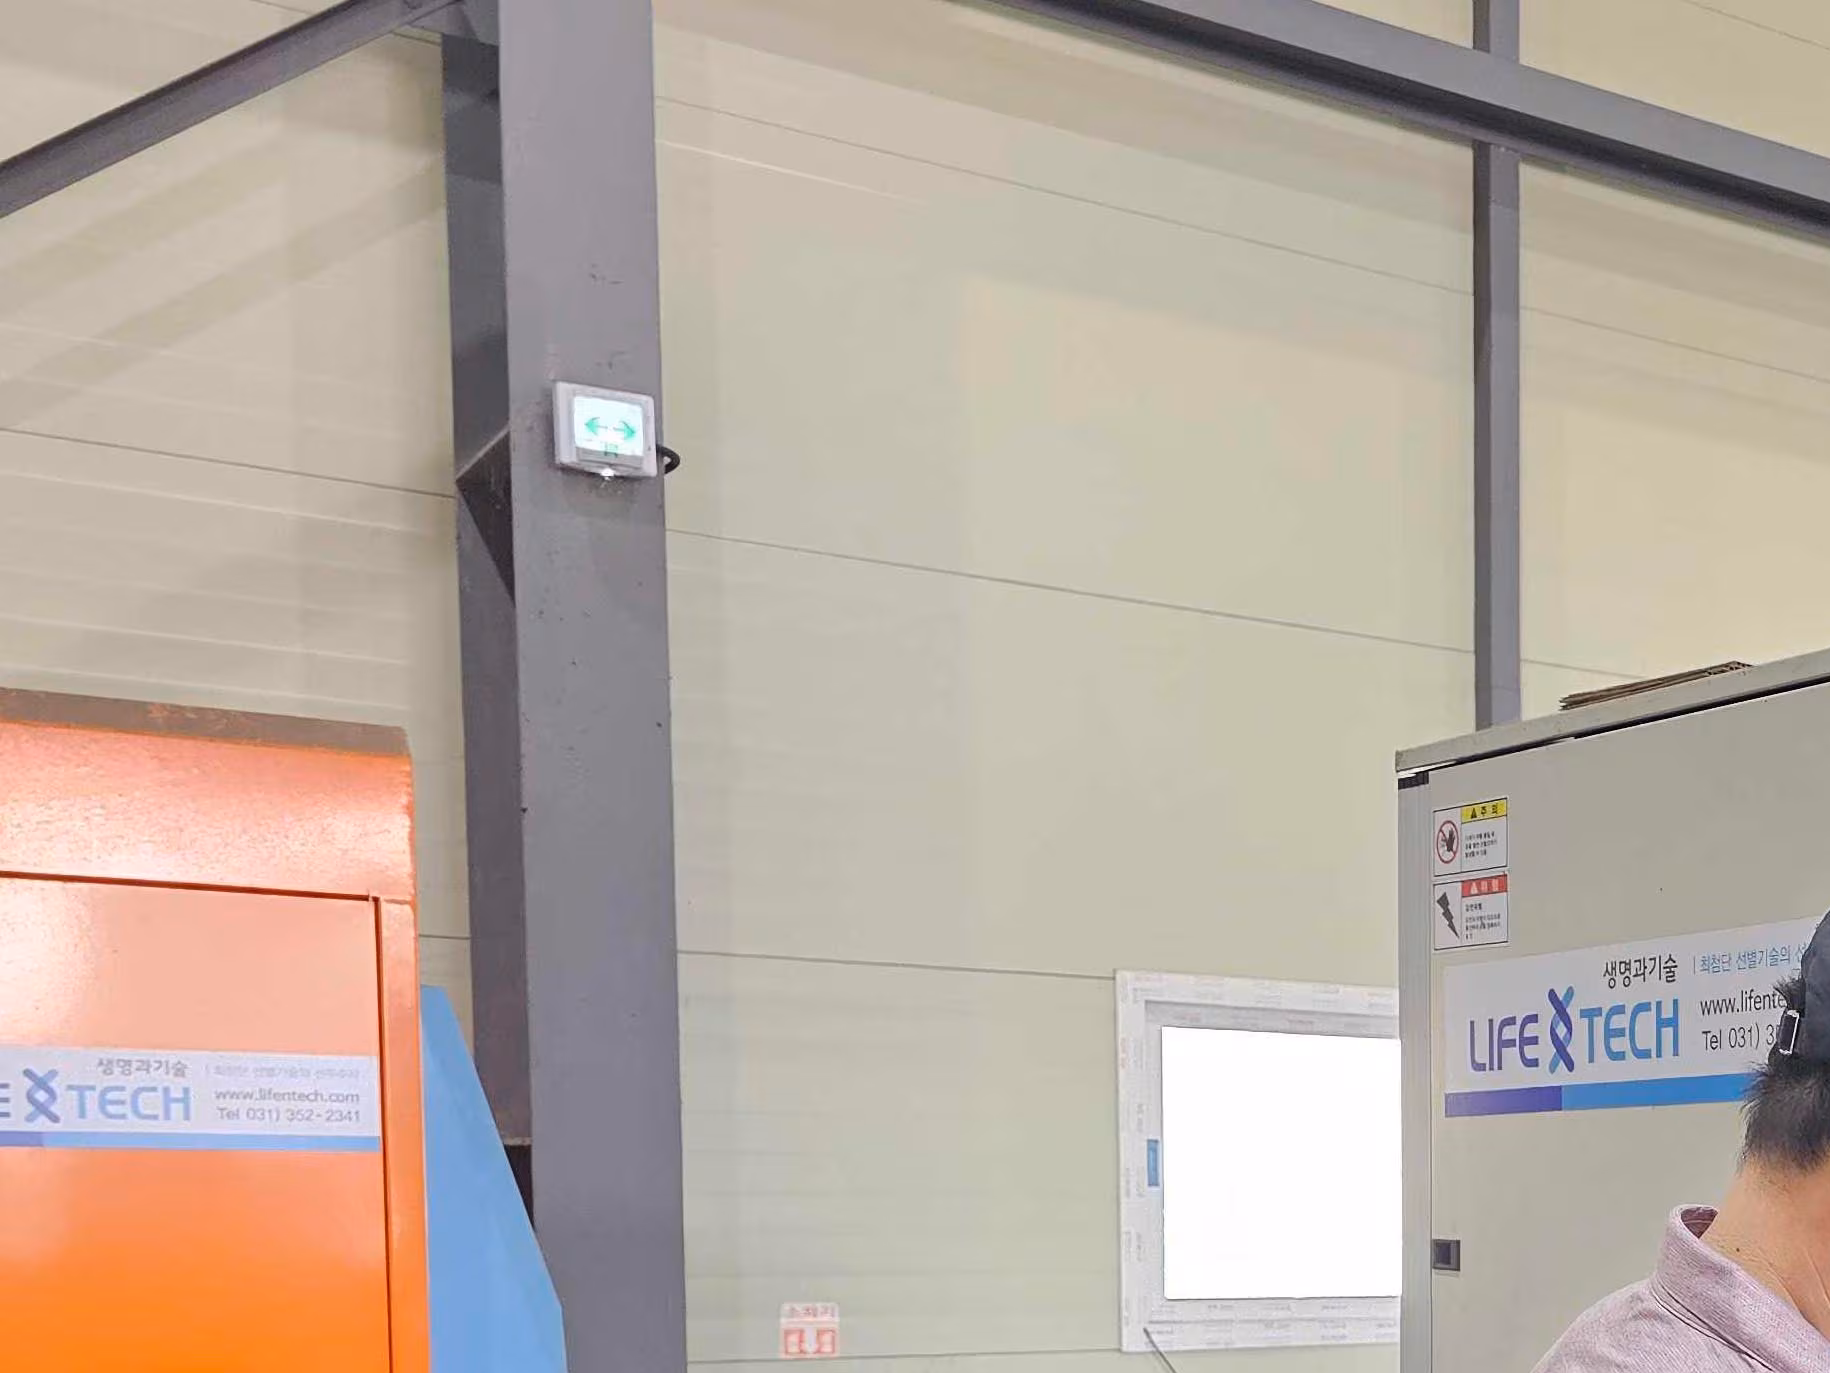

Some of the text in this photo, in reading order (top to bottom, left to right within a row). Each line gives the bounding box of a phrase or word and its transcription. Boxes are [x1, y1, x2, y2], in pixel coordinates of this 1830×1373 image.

[1603, 953, 1678, 989] 생명과기술
[1699, 953, 1731, 974] 최첨단
[1736, 945, 1791, 970] 선별기술의
[1700, 988, 1788, 1017] www.lifente
[1469, 998, 1680, 1073] LIFE TECH
[1702, 1029, 1722, 1051] Tel
[1728, 1022, 1760, 1050] 031)
[98, 1058, 188, 1077] 생명과기술
[66, 1084, 191, 1121] TECH
[214, 1087, 360, 1104] www.lifentech.com
[217, 1106, 240, 1121] Tel
[246, 1107, 281, 1122] 031)
